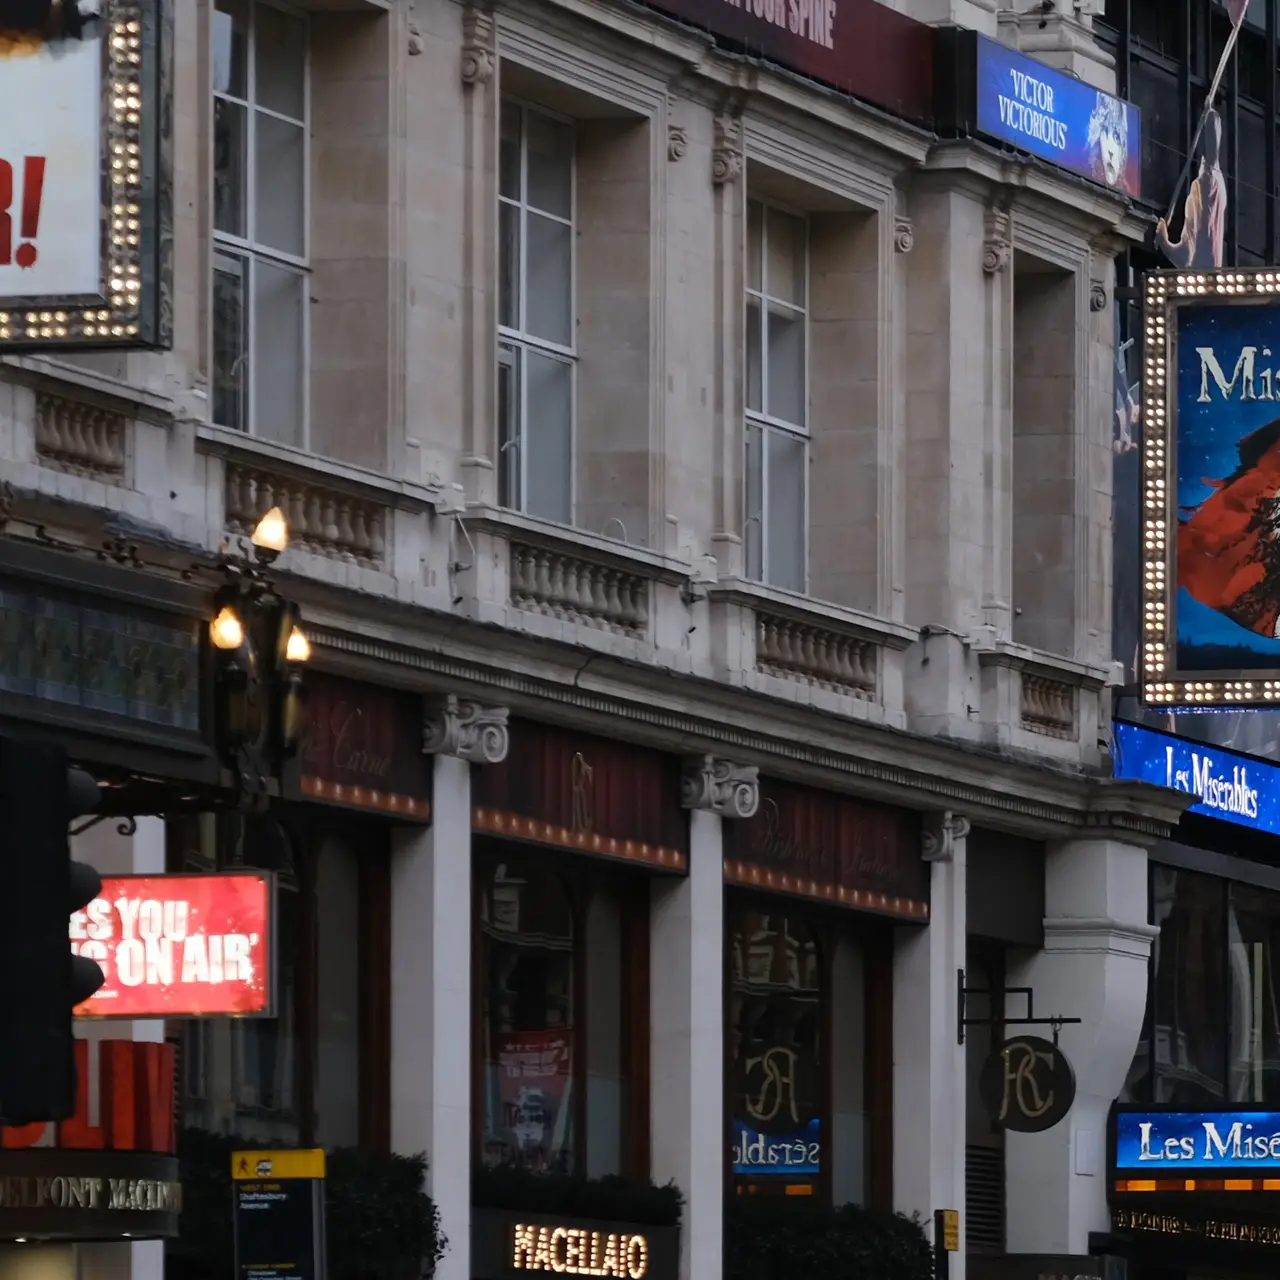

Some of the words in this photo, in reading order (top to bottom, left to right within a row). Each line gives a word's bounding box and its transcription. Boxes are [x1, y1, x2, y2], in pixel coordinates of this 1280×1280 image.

[1166, 746, 1190, 790] Les
[114, 899, 189, 943] YOU
[116, 938, 175, 987] ON
[1138, 1121, 1195, 1161] Les
[513, 1222, 648, 1280] MACELLAIO
